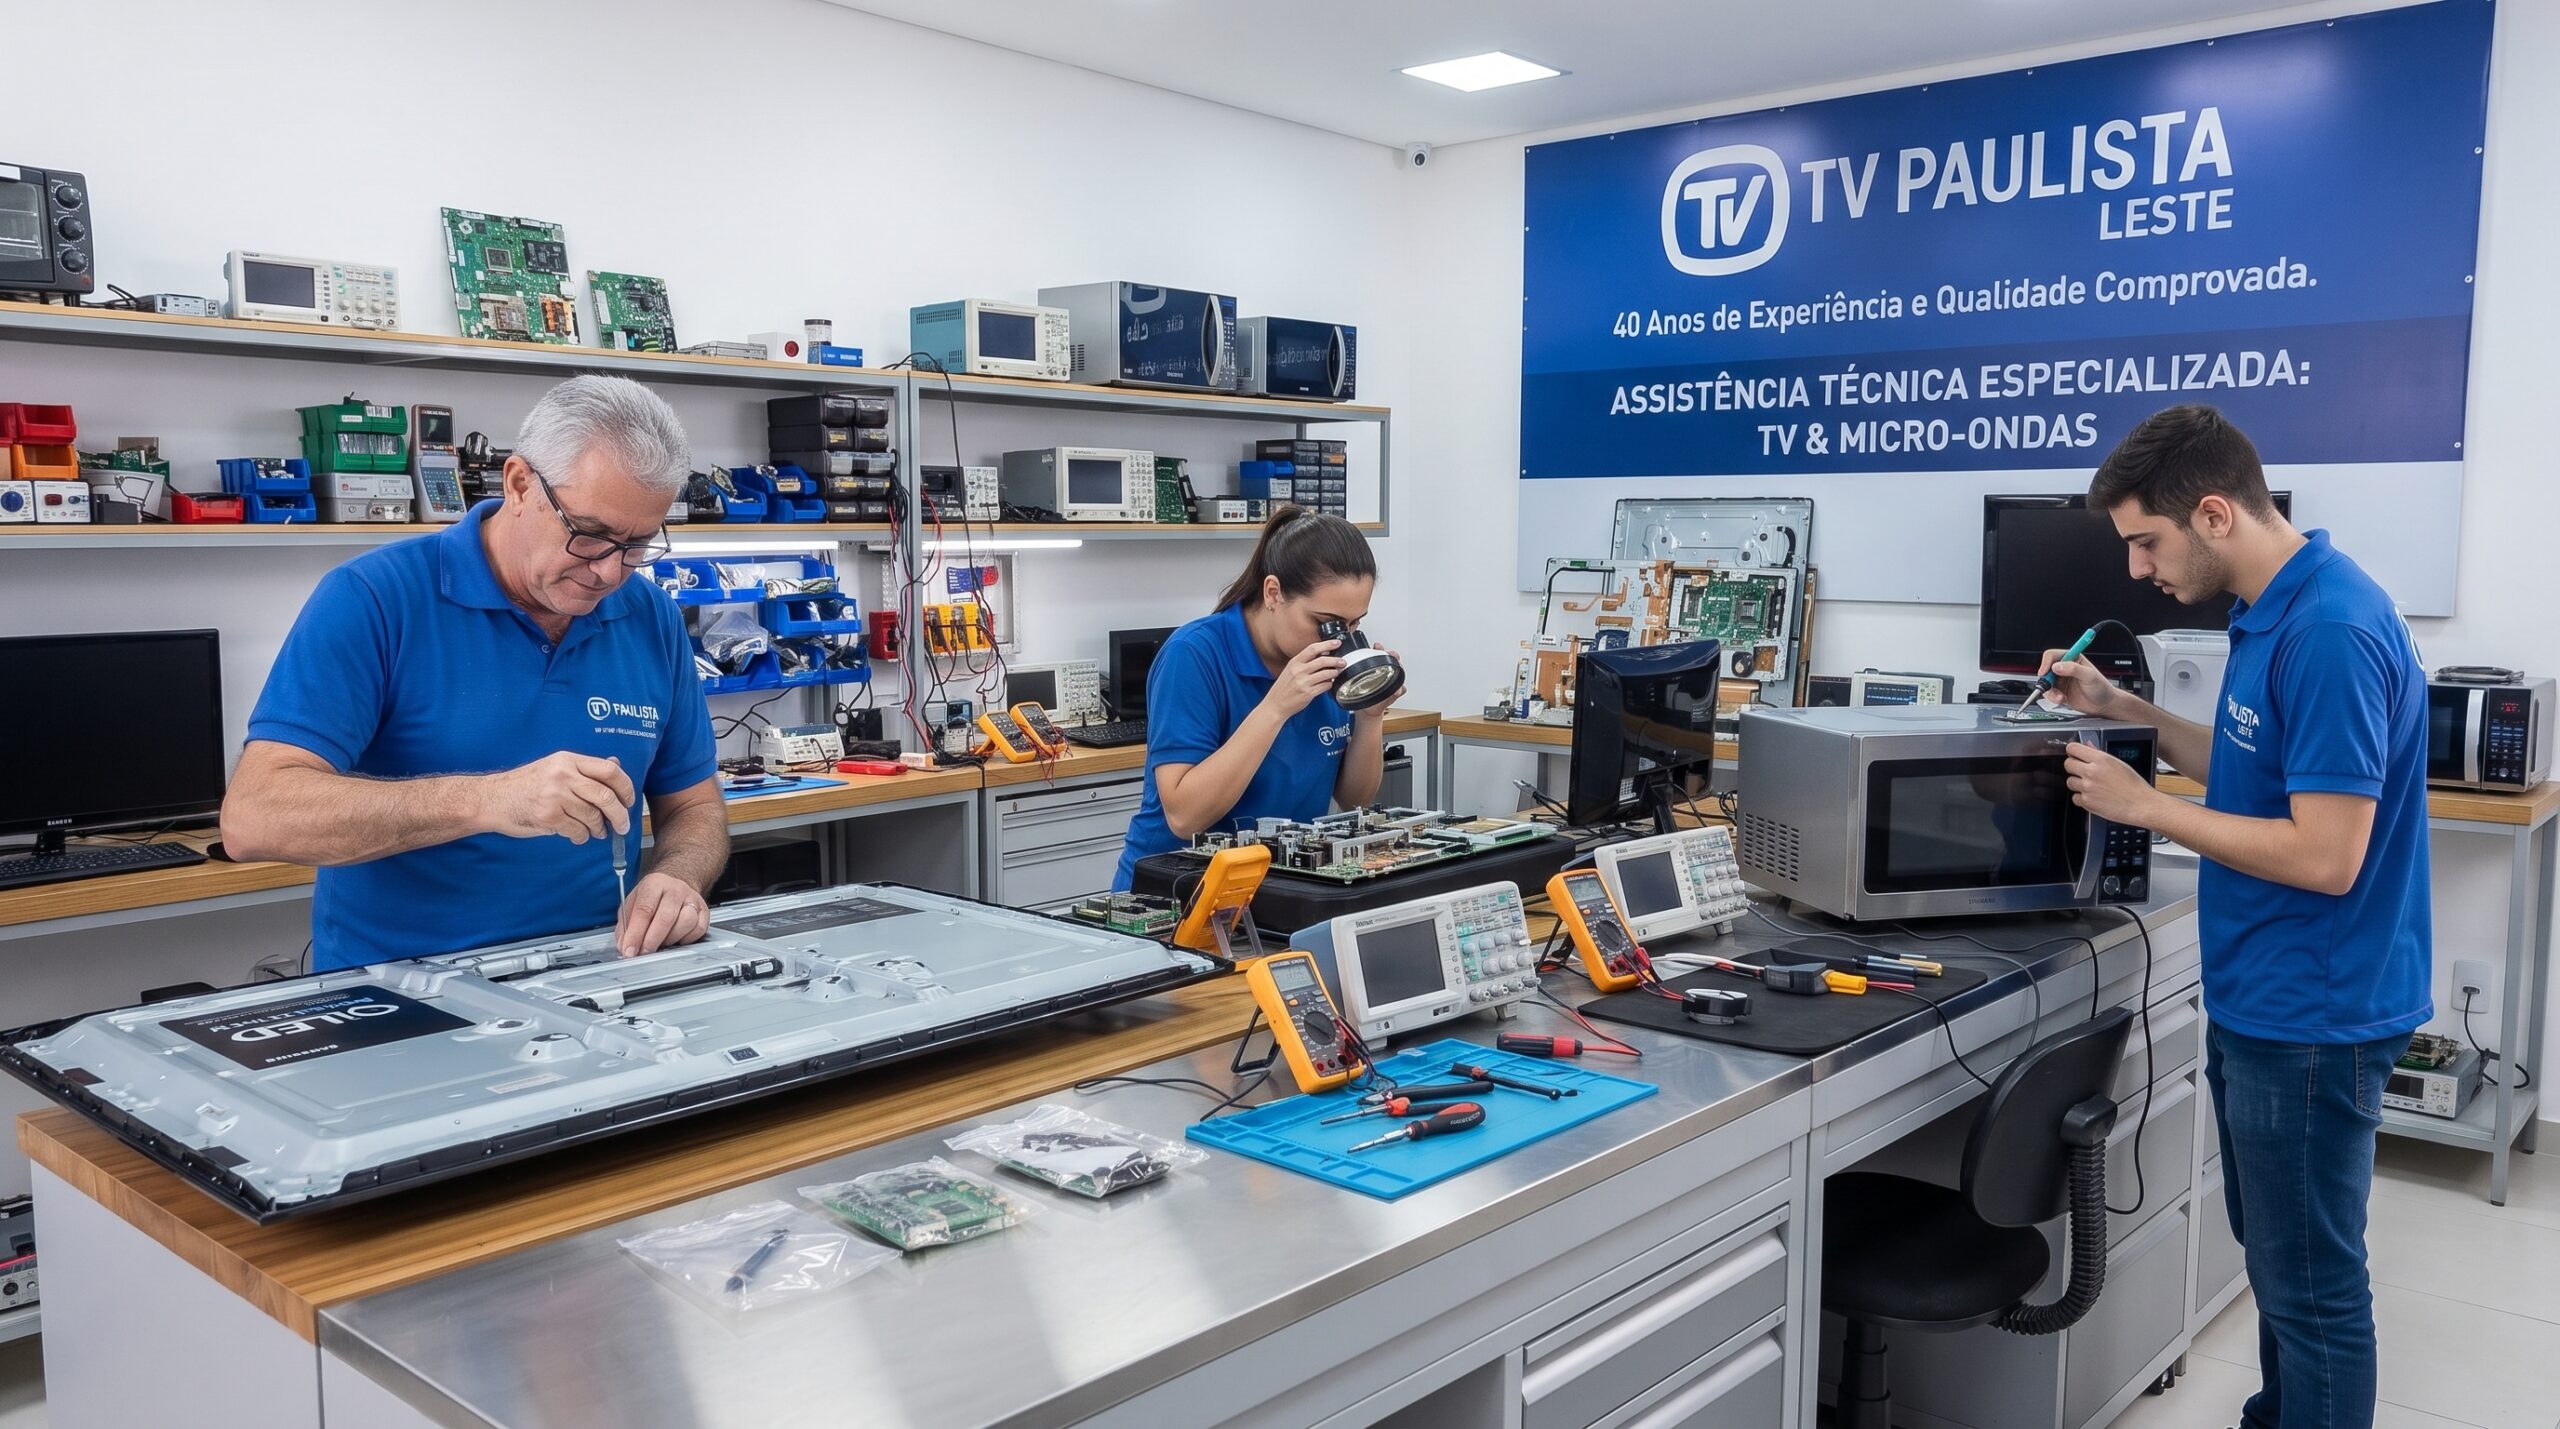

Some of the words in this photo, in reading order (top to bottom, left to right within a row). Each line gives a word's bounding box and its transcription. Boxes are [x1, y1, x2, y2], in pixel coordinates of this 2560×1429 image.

[1801, 153, 1879, 222] TV
[1898, 106, 2232, 212] PAULISTA
[1684, 175, 1767, 248] TV
[2100, 188, 2233, 240] LESTE
[1614, 312, 1646, 337] 40
[1646, 310, 1705, 335] Anos
[1713, 304, 1741, 330] de
[1750, 290, 1902, 333] Experiência
[1912, 295, 1927, 315] e
[1937, 280, 2085, 314] Qualidade
[2096, 257, 2316, 305] Comprovada.
[1611, 372, 1809, 414] ASSISTÊNCIA
[1819, 364, 1968, 405] TÉCNICA
[1980, 349, 2309, 398] ESPECIALIZADA:
[1758, 425, 1797, 455] TV
[1806, 423, 1828, 454] &
[1840, 413, 2097, 453] MICRO-ONDAS
